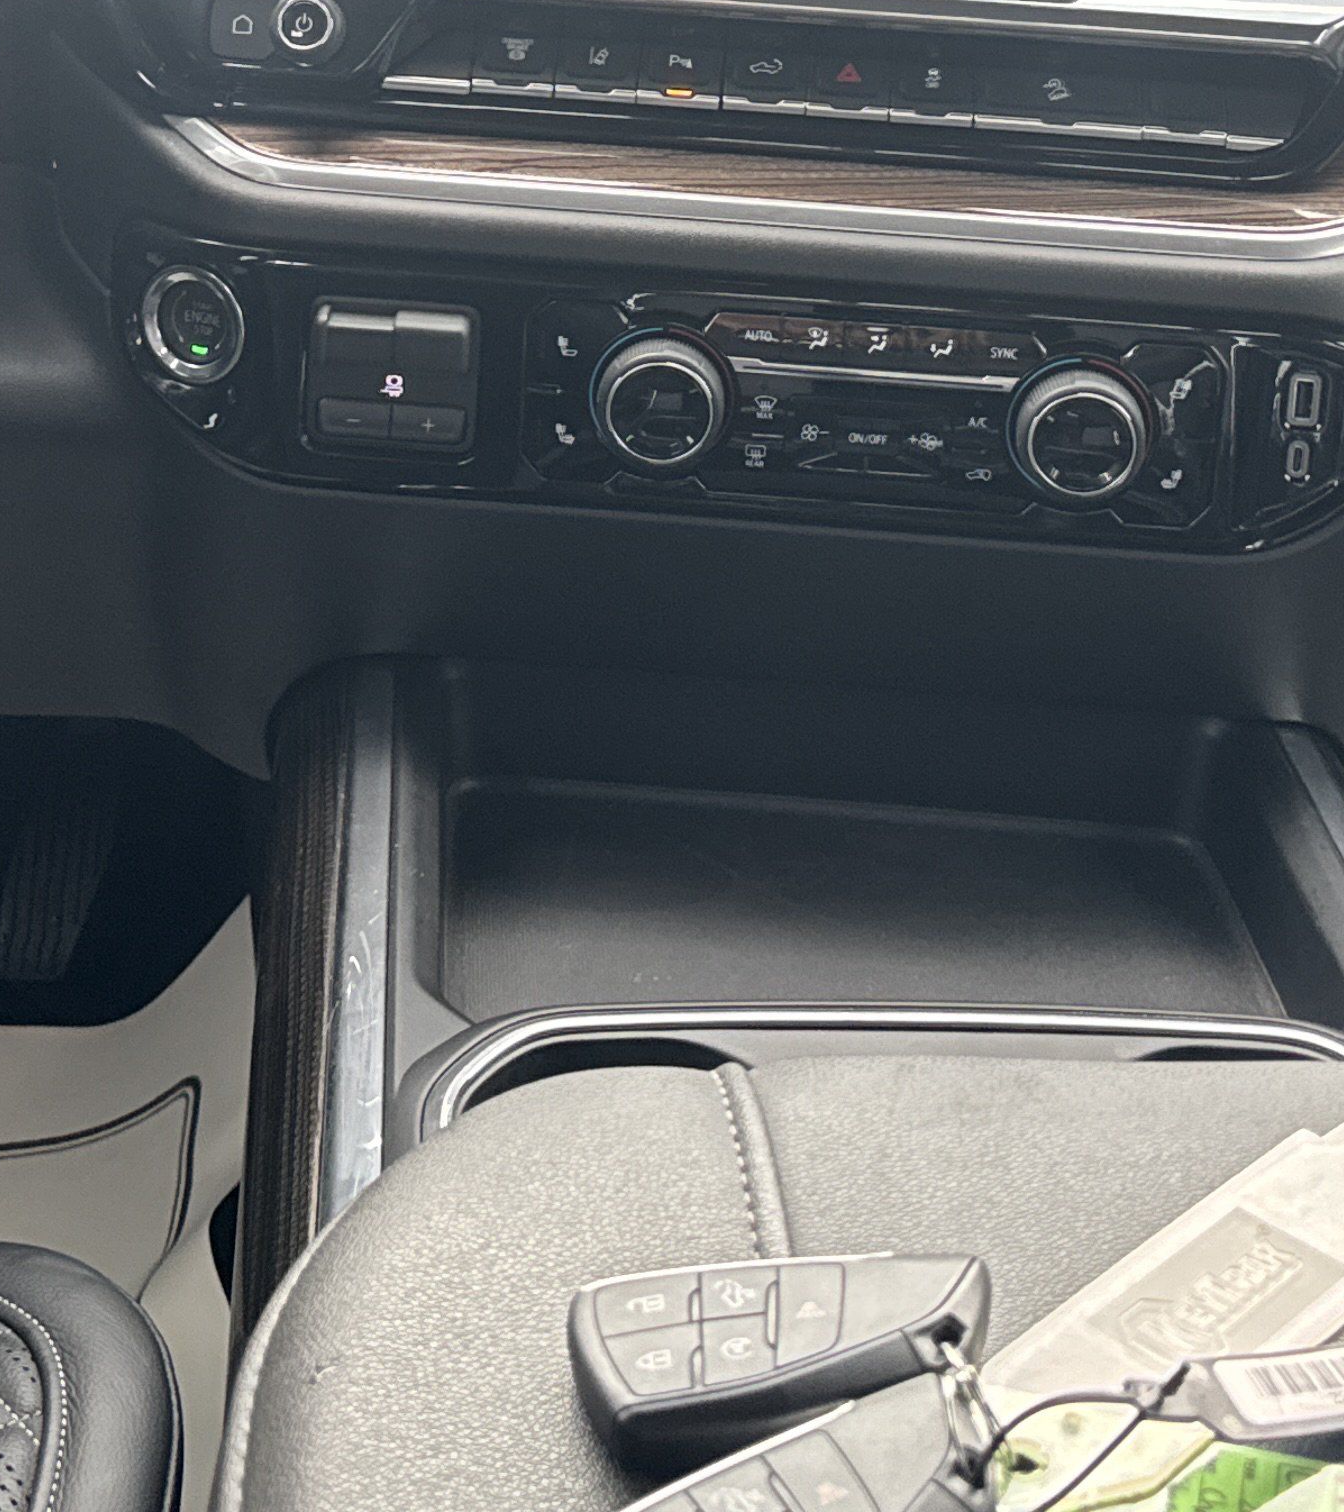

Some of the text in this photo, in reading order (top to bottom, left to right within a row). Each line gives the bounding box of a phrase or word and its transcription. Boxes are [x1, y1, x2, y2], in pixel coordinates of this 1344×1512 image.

[744, 329, 774, 343] AUTO
[989, 345, 1019, 361] SYNC
[967, 415, 988, 430] A/C
[847, 432, 888, 447] ON/OFF
